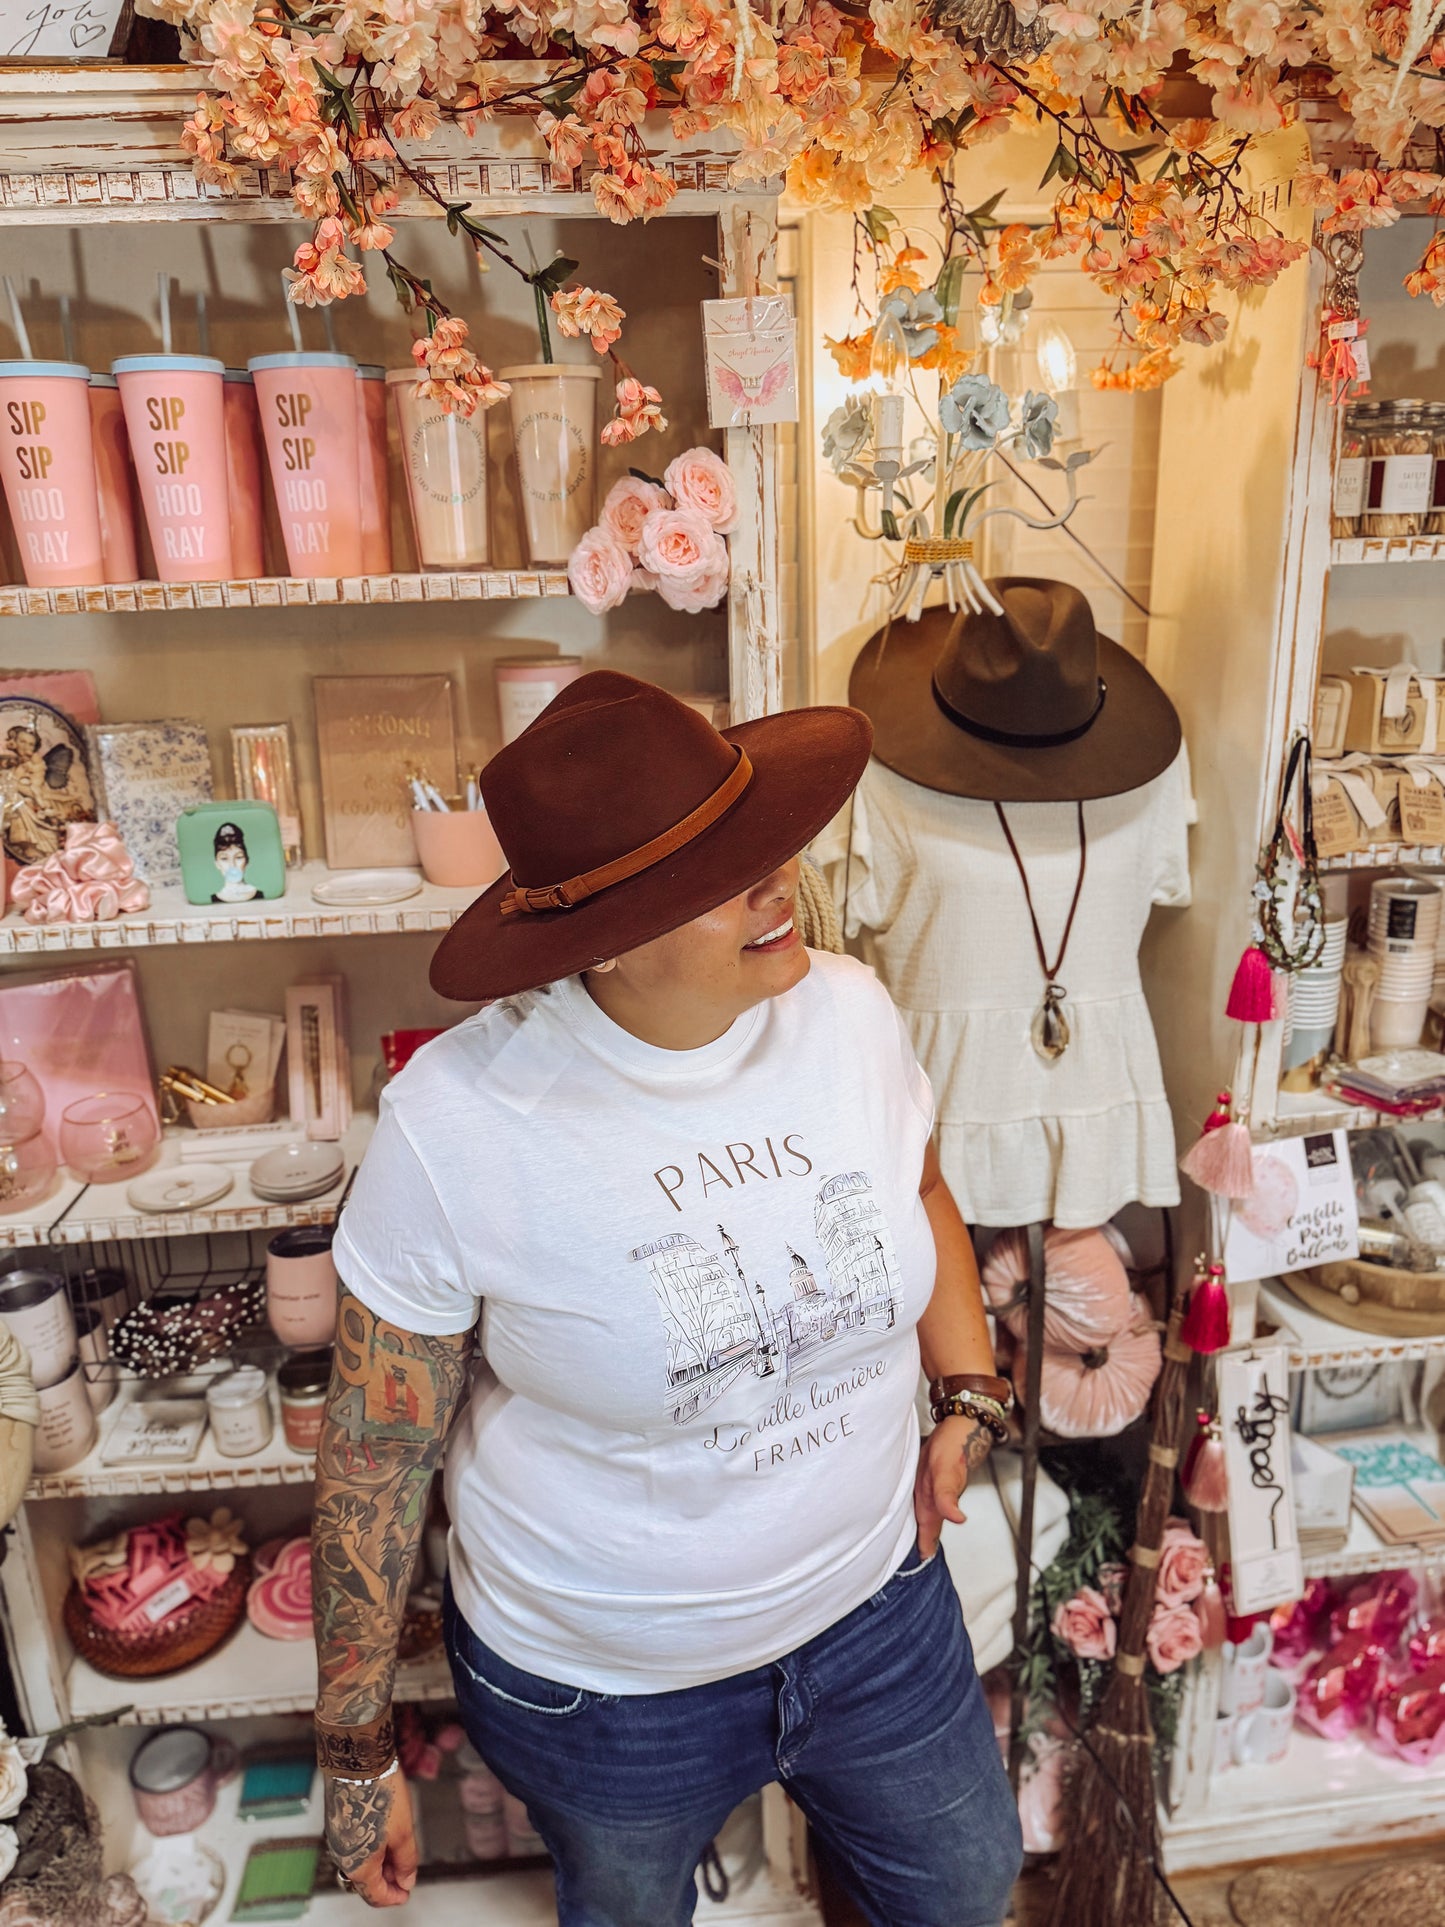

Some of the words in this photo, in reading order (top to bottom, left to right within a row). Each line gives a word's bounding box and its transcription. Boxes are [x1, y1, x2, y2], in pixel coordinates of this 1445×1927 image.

[728, 347, 749, 360] Angel
[7, 401, 46, 435] SIP
[146, 397, 185, 431] SIP
[275, 393, 312, 427] SIP
[16, 446, 53, 479] SIP
[153, 441, 190, 475] SIP
[282, 438, 316, 471] SIP
[17, 488, 65, 521] HOO
[155, 484, 202, 517] HOO
[284, 479, 327, 512] HOO
[26, 531, 69, 563] RAY
[163, 526, 205, 558] RAY
[292, 521, 330, 554] RAY
[653, 1134, 813, 1212] PARIS
[1287, 1200, 1344, 1229] Confetti
[1300, 1223, 1343, 1244] Party
[1286, 1239, 1348, 1266] Balloons
[704, 1423, 752, 1451] La
[757, 1392, 806, 1433] ville
[810, 1360, 886, 1410] lumière
[754, 1413, 854, 1471] FRANCE
